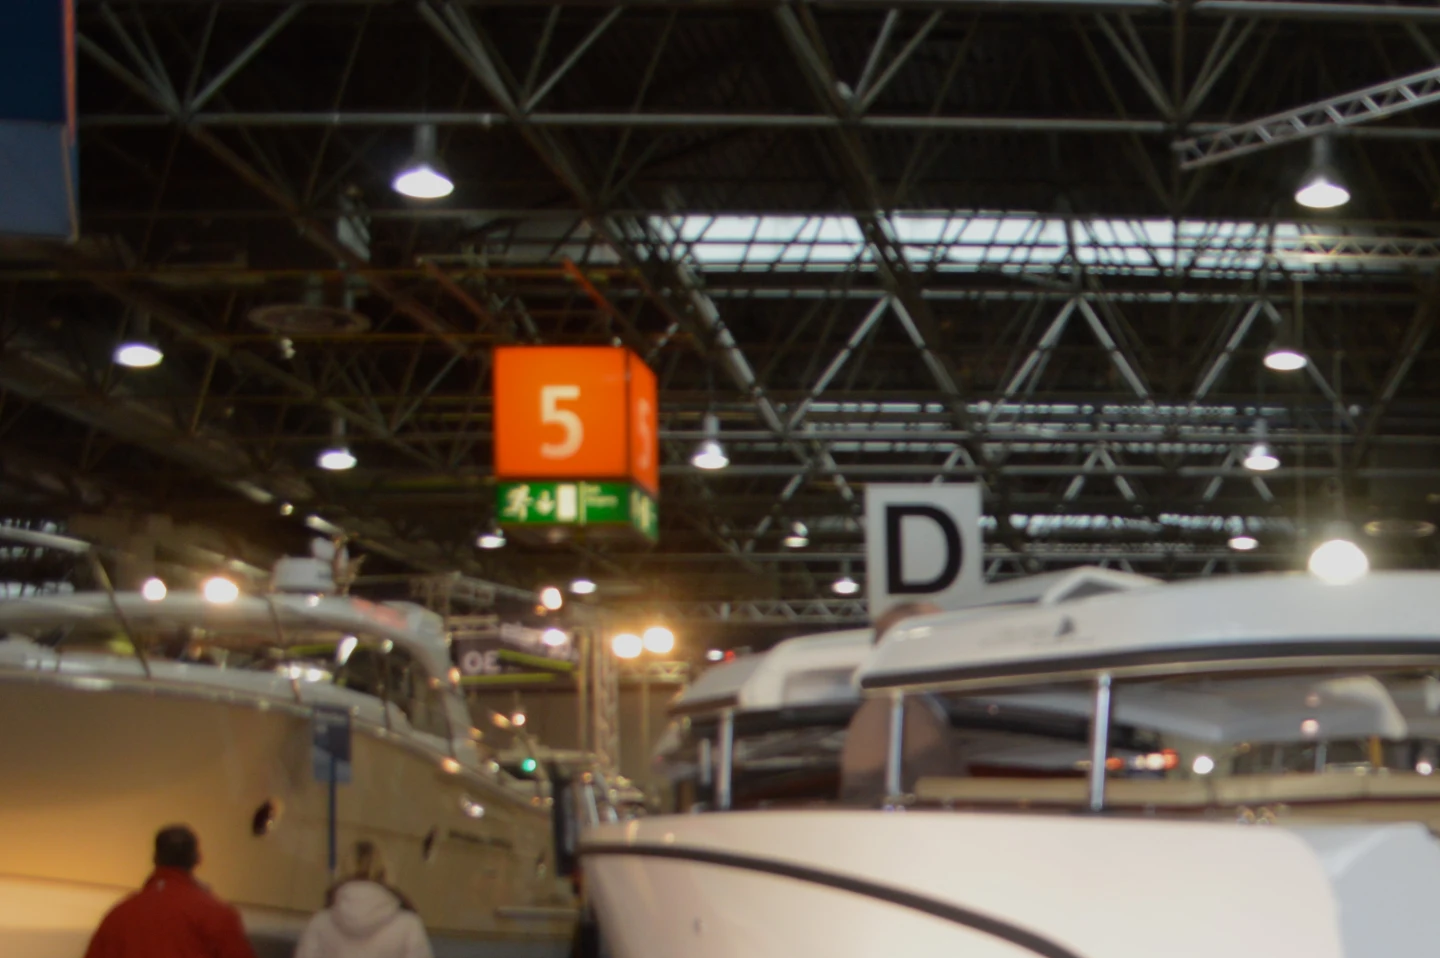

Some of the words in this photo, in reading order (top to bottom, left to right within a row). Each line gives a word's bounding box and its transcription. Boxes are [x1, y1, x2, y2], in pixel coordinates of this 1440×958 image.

[540, 385, 584, 460] 5
[637, 397, 652, 470] 5
[886, 504, 963, 595] D
